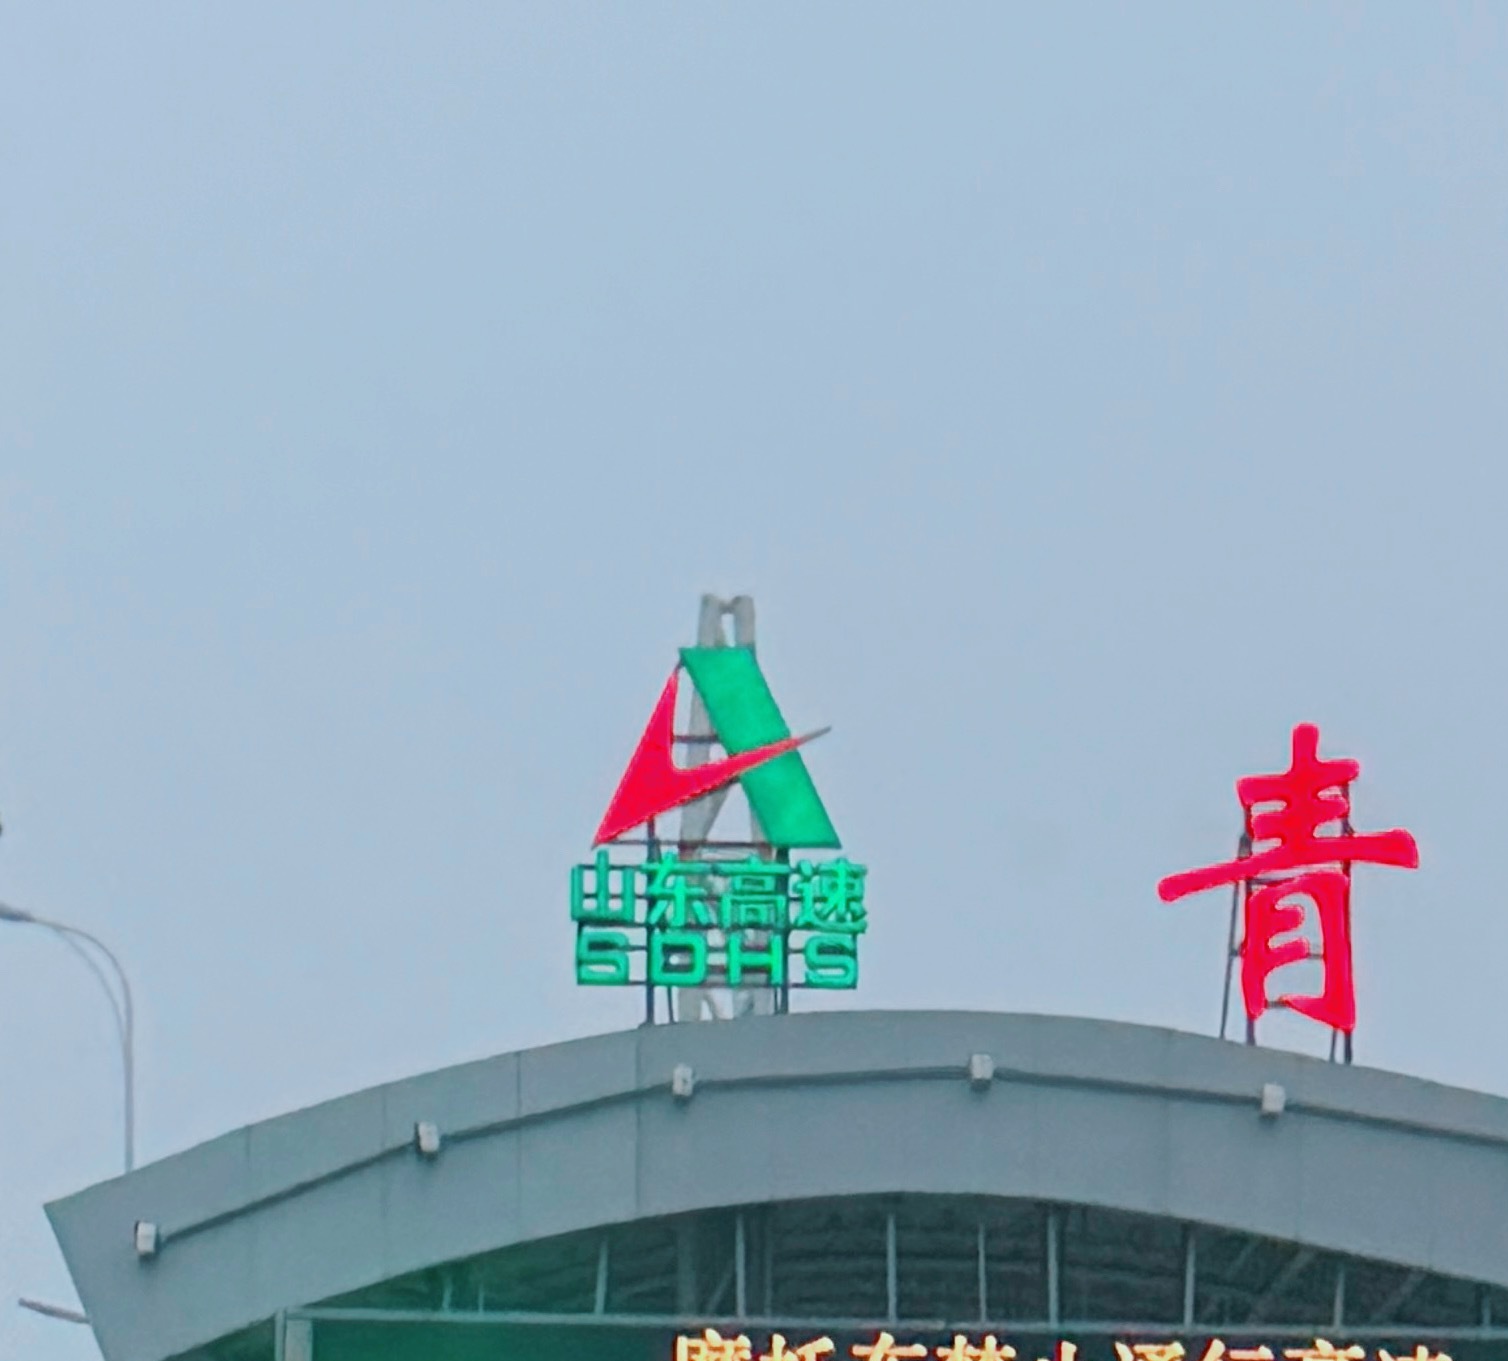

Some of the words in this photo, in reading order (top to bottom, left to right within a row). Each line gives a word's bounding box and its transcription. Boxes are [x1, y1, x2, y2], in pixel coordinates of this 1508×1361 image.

[570, 848, 868, 934] 山东高速
[576, 930, 859, 989] SDHS
